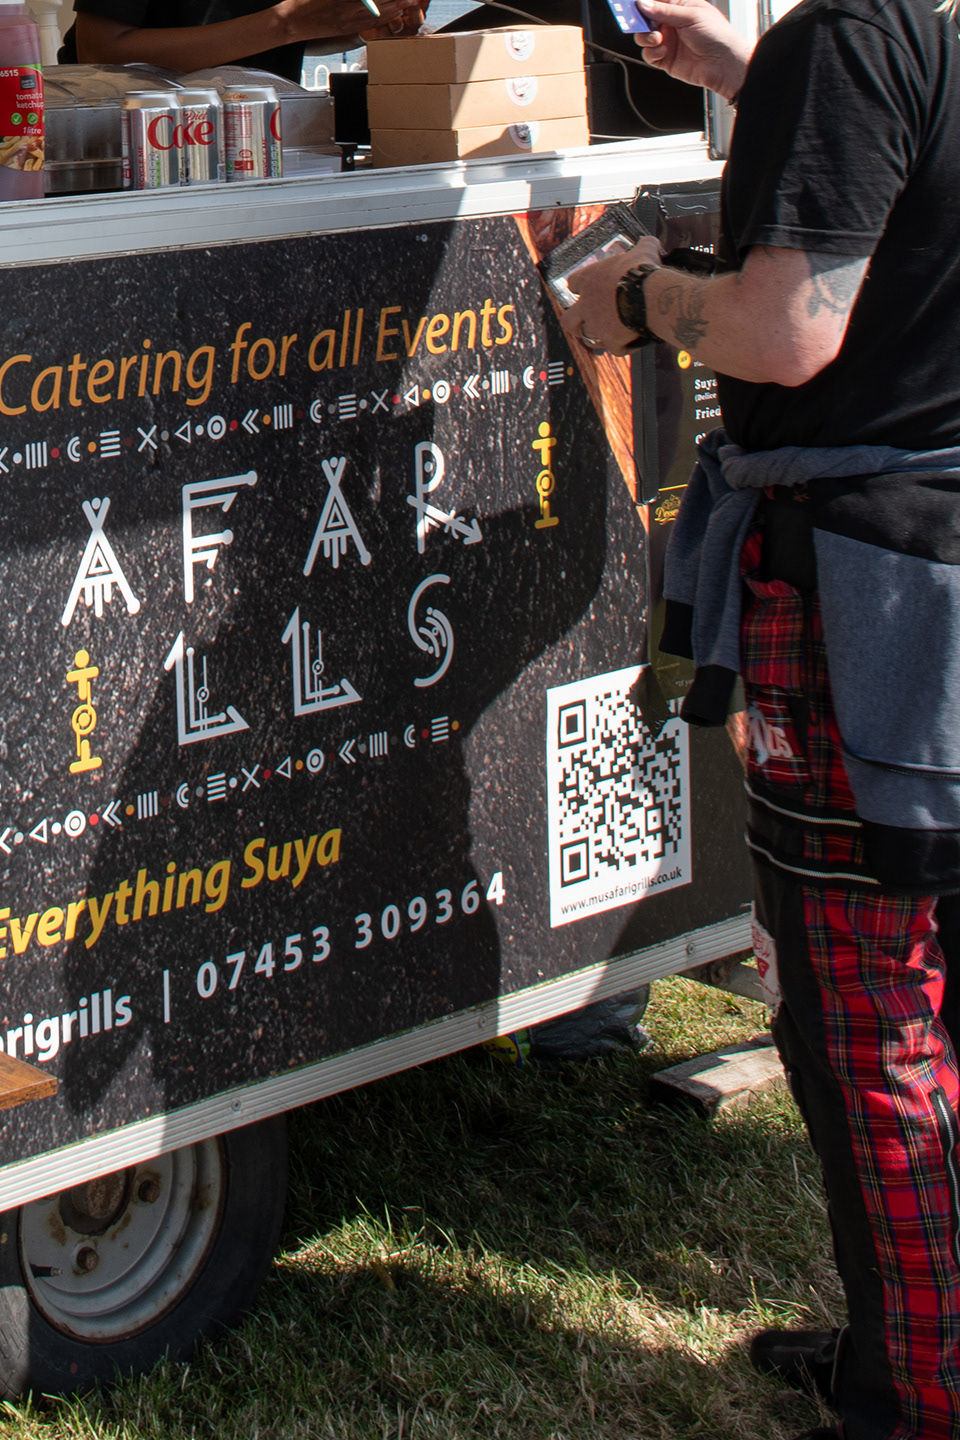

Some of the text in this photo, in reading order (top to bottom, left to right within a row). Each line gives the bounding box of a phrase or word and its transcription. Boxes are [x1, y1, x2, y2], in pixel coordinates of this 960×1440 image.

[16, 92, 43, 100] tomato
[230, 322, 298, 385] for
[308, 307, 364, 373] all
[376, 298, 515, 363] Events
[695, 406, 722, 420] Fried
[241, 828, 341, 888] Suya
[561, 866, 682, 915] www.musafarigrills.co.uk
[196, 926, 331, 999] 07453
[354, 871, 506, 949] 309364
